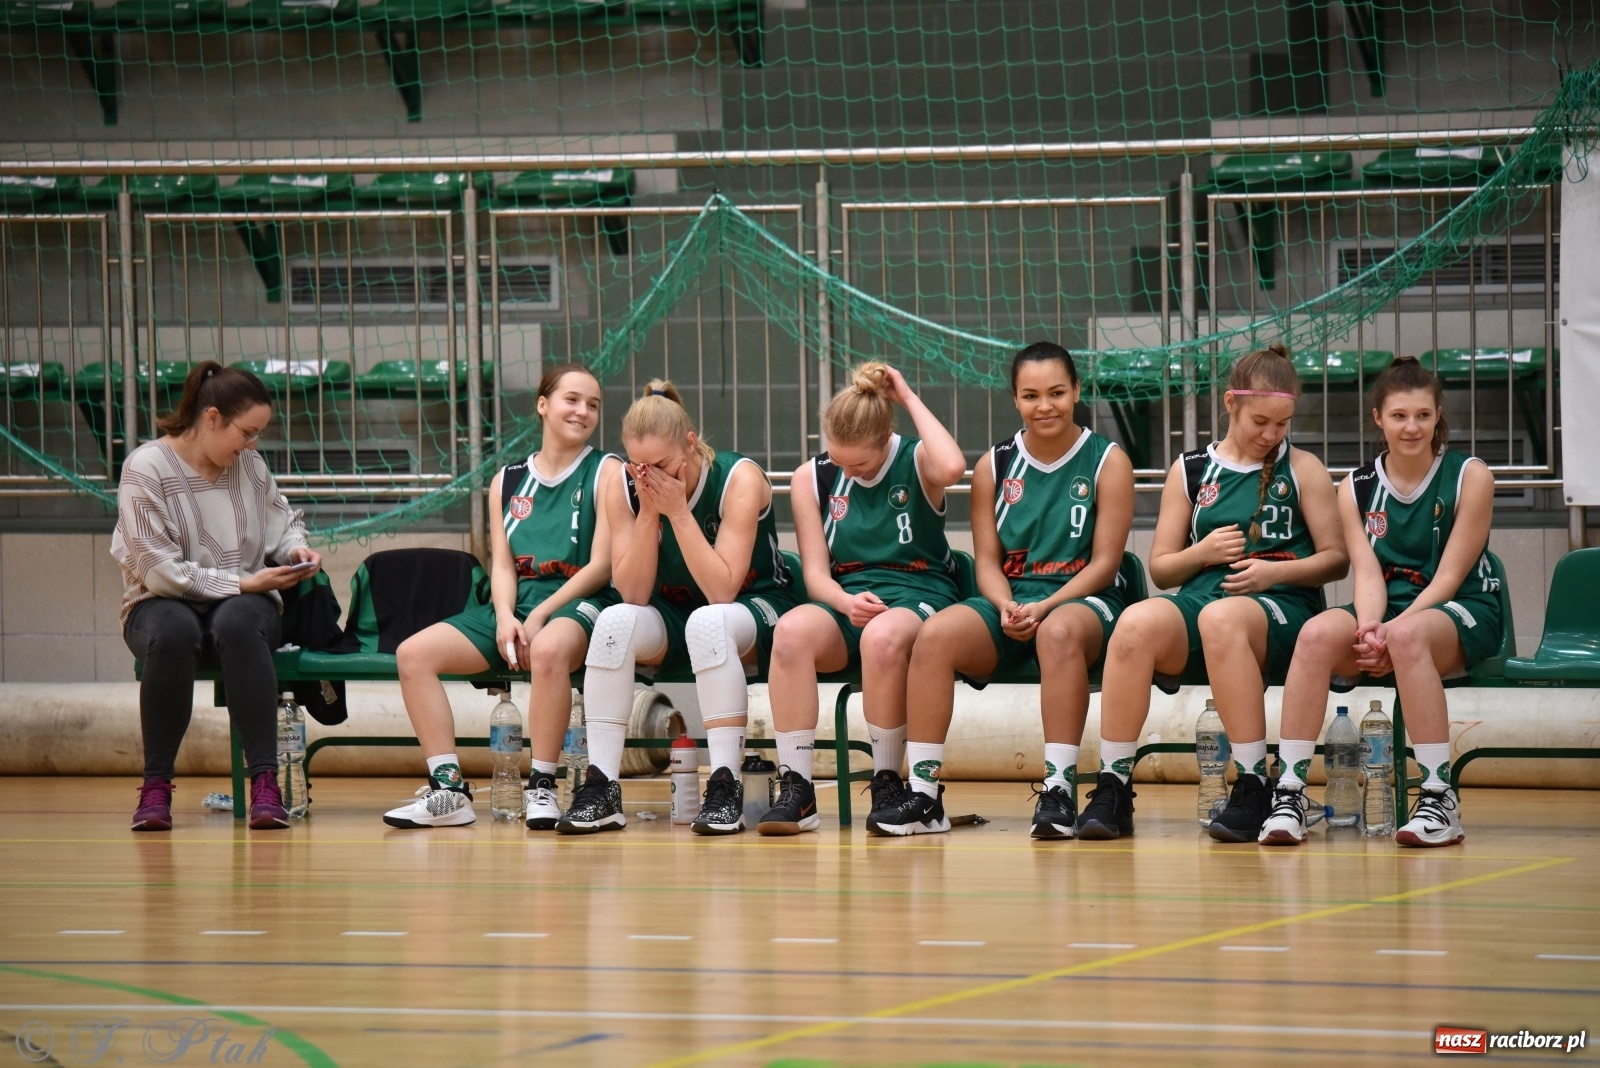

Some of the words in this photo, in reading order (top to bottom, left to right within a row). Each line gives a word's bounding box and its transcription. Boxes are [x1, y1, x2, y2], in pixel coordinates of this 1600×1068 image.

[896, 512, 913, 544] 8
[1070, 505, 1086, 538] 9
[1261, 505, 1292, 539] 23
